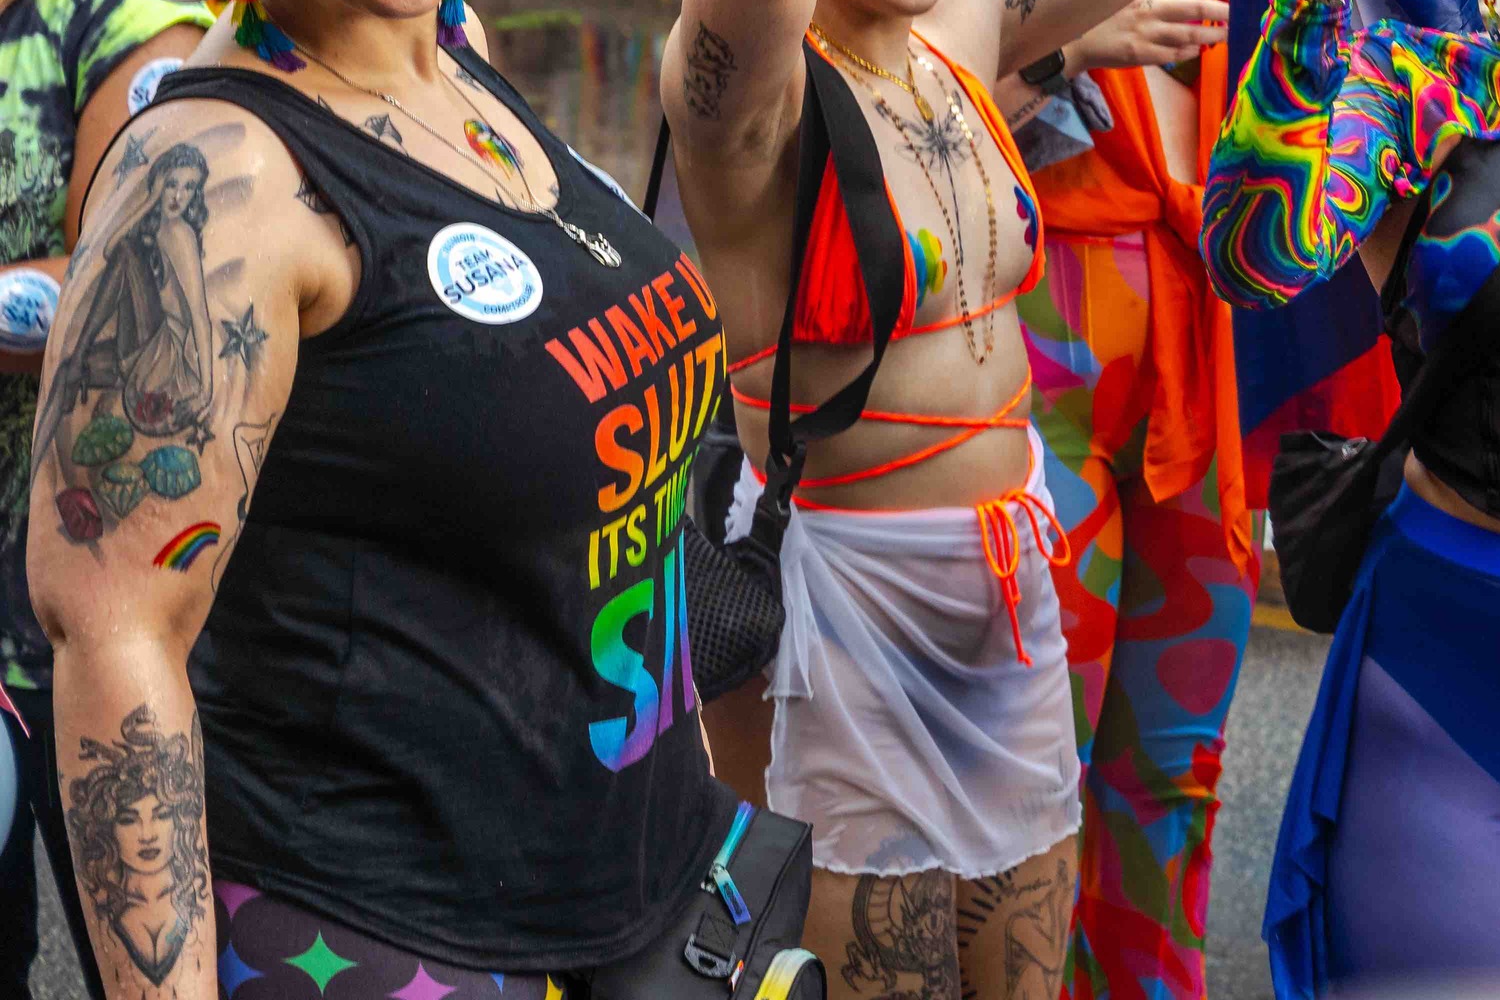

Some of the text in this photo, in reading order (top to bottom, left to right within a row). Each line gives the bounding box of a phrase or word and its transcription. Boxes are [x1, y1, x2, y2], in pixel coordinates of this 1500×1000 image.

[444, 253, 528, 304] SUSANA
[454, 248, 493, 271] TEAM
[544, 251, 717, 404] WAKE U
[588, 503, 647, 590] ITS
